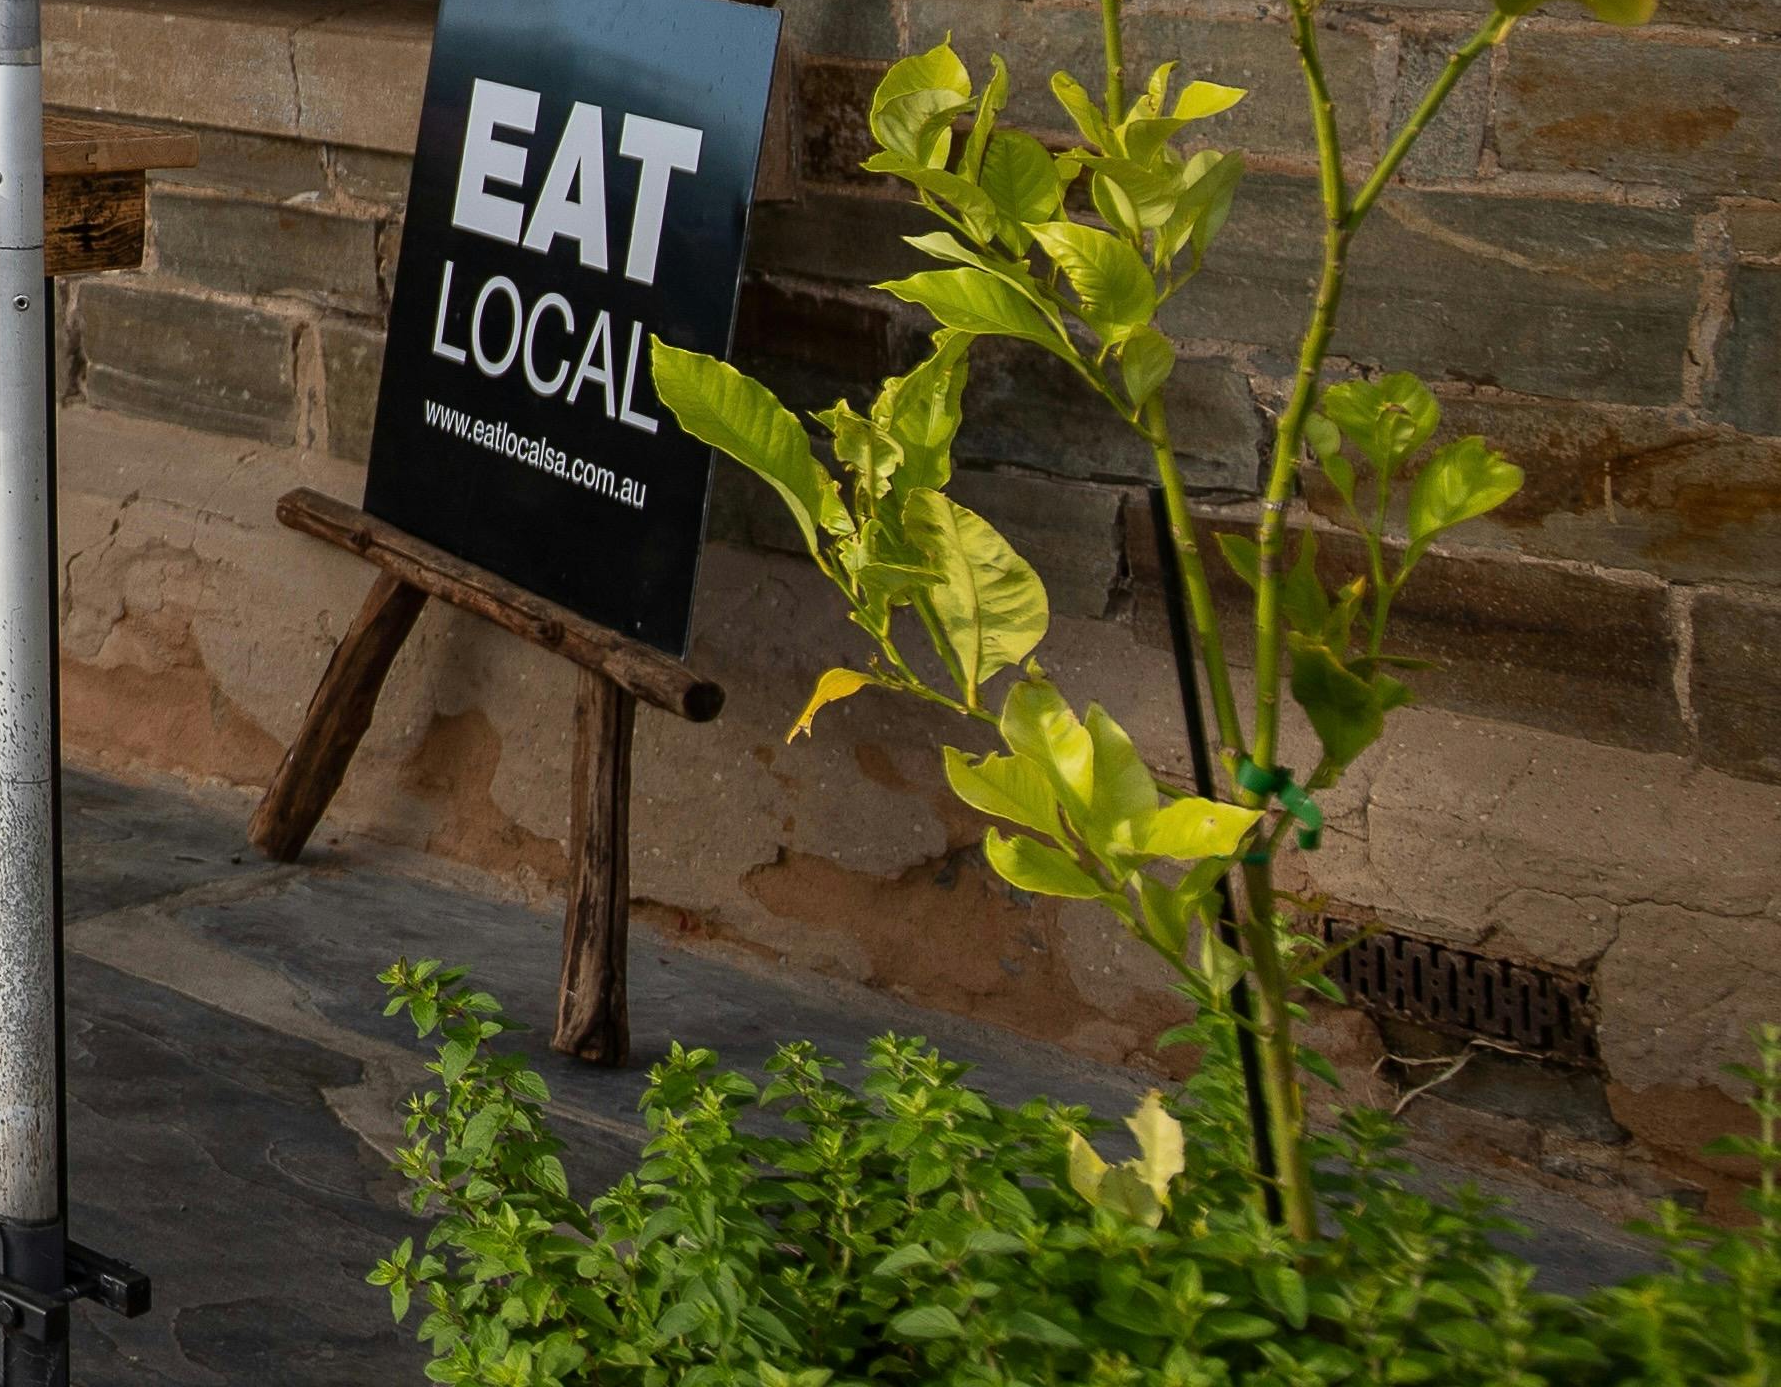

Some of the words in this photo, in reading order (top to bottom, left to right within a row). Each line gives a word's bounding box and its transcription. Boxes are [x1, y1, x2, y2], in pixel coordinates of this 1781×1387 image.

[451, 77, 704, 286] EAT
[432, 260, 659, 435] LOCAL
[424, 399, 646, 510] www.eatlocalsa.com.au
